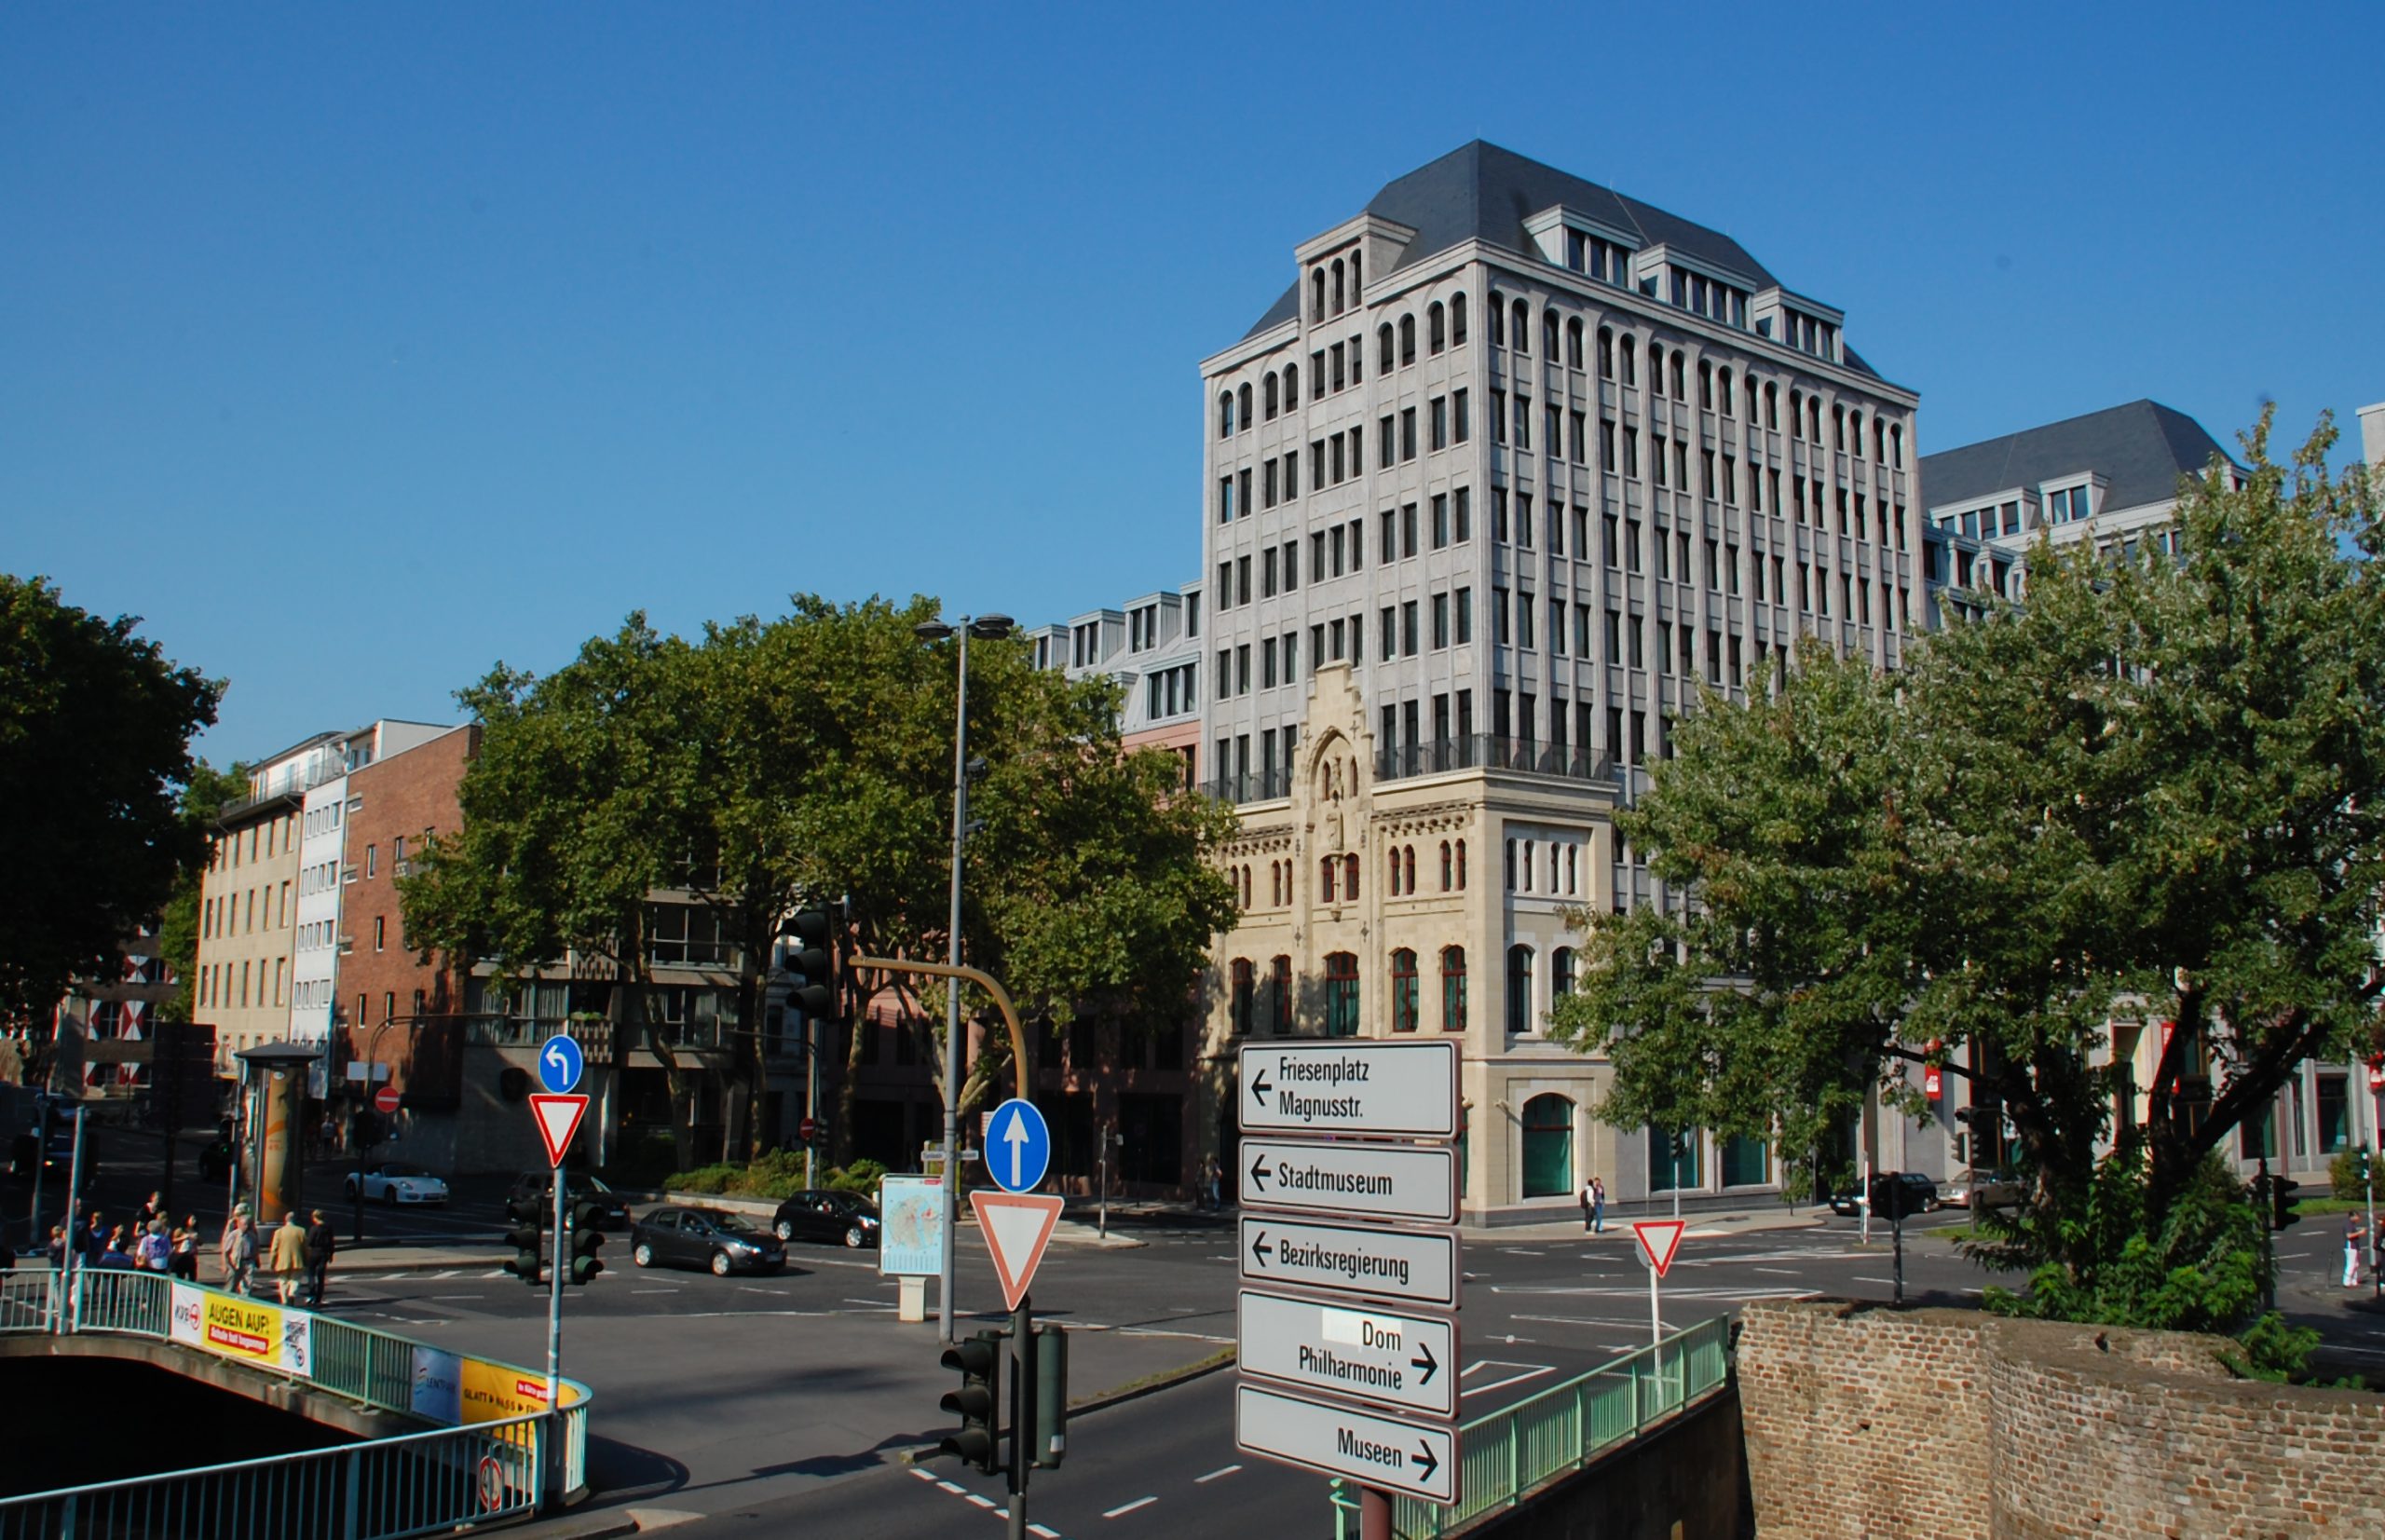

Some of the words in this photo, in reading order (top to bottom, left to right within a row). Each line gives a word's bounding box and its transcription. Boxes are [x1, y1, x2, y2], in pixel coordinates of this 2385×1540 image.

[1279, 1056, 1370, 1087] Friesenplatz
[1279, 1090, 1363, 1122] Magnusstr.
[1278, 1162, 1393, 1195] Stadtmuseum
[1280, 1239, 1409, 1286] Bezirksregierung
[210, 1303, 243, 1329] AUGEN
[246, 1312, 269, 1335] AUF!
[1362, 1320, 1401, 1352] Dom
[1299, 1344, 1402, 1391] Philharmonie
[464, 1388, 486, 1403] GLATT
[1338, 1426, 1402, 1468] Museen
